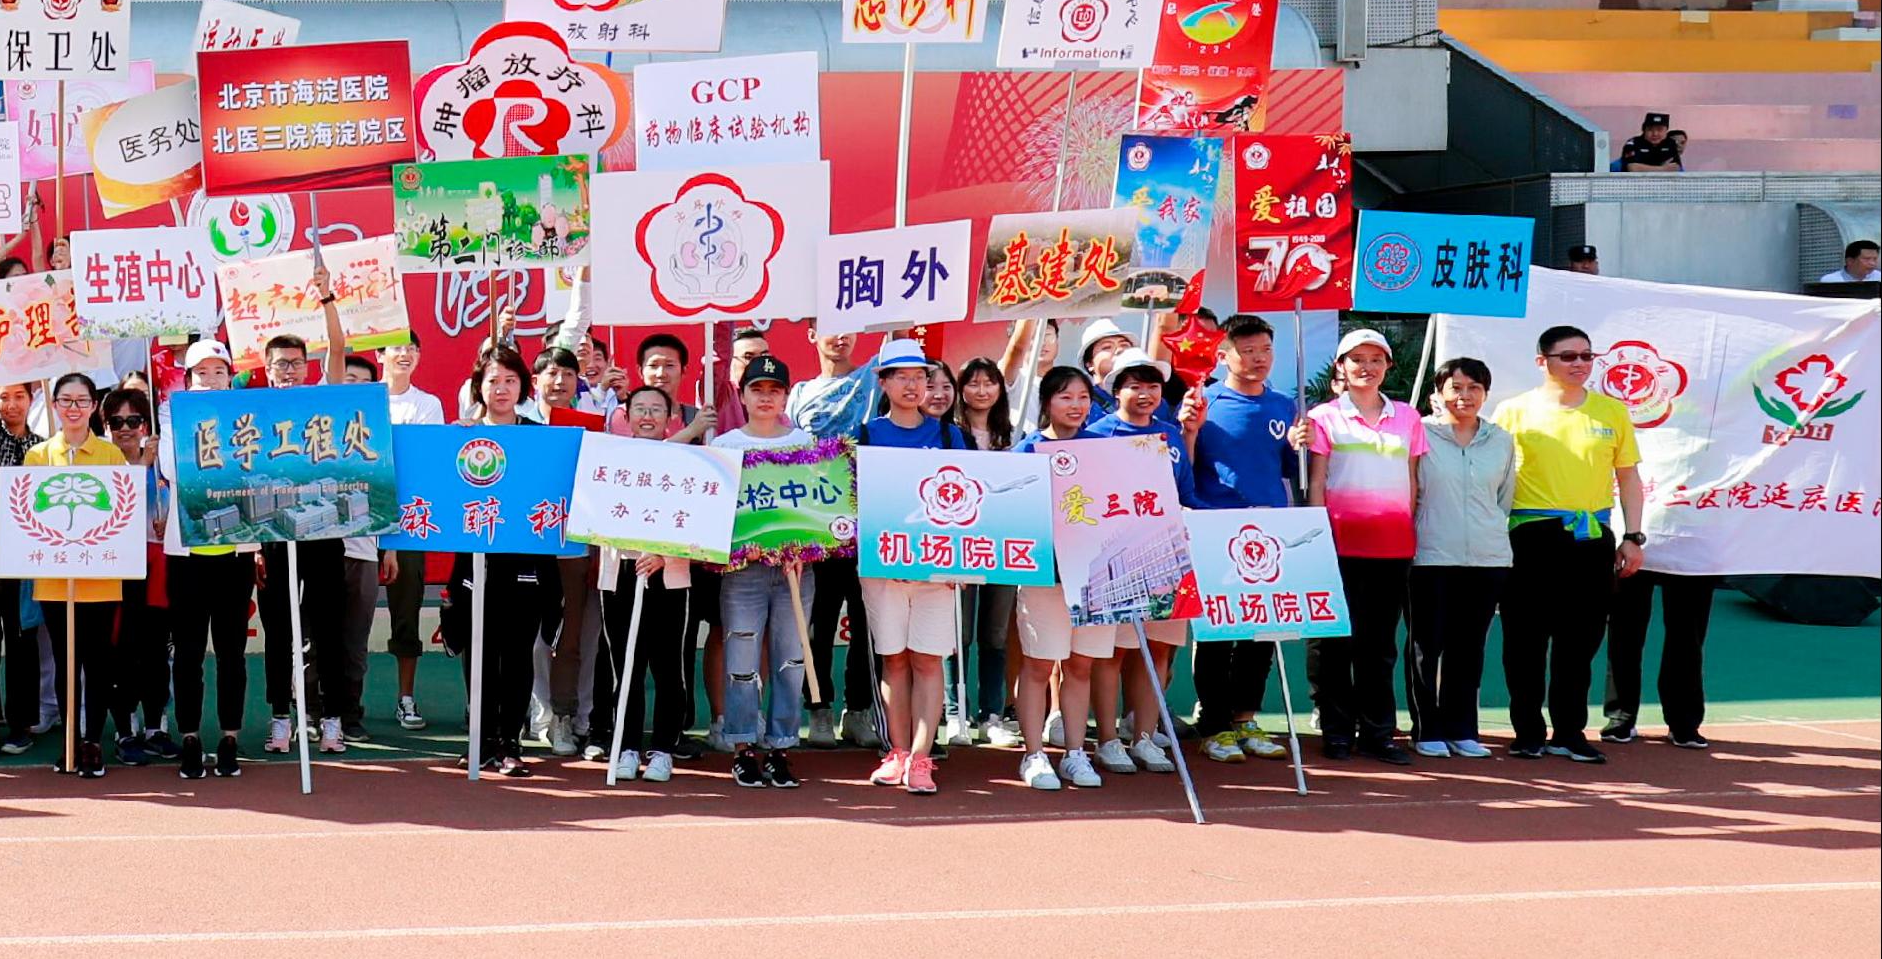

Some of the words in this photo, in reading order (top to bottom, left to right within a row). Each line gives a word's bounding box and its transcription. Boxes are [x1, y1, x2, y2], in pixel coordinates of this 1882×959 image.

[567, 22, 650, 41] 放射科
[5, 30, 117, 73] 保卫处
[1040, 48, 1118, 59] Information
[218, 75, 390, 110] 北京市海淀医院
[432, 53, 606, 139] 肿瘤放疗科
[690, 76, 762, 104] GCP
[213, 117, 407, 154] 北医三院海淀院区
[645, 113, 813, 148] 药物临床试验机构
[1249, 185, 1338, 224] 爱祖国
[85, 249, 206, 305] 生殖中心
[836, 247, 950, 311] 胸外
[991, 227, 1122, 306] 基建处
[1431, 237, 1523, 293] 皮肤科
[196, 411, 379, 471] 医学工程处
[592, 465, 720, 496] 医院服务管理
[399, 496, 568, 547] 麻醉科
[610, 503, 691, 529] 办公室
[1060, 485, 1165, 526] 爱三院
[27, 548, 118, 566] 神经外科
[879, 532, 1039, 571] 机场院区
[1205, 591, 1338, 627] 机场院区
